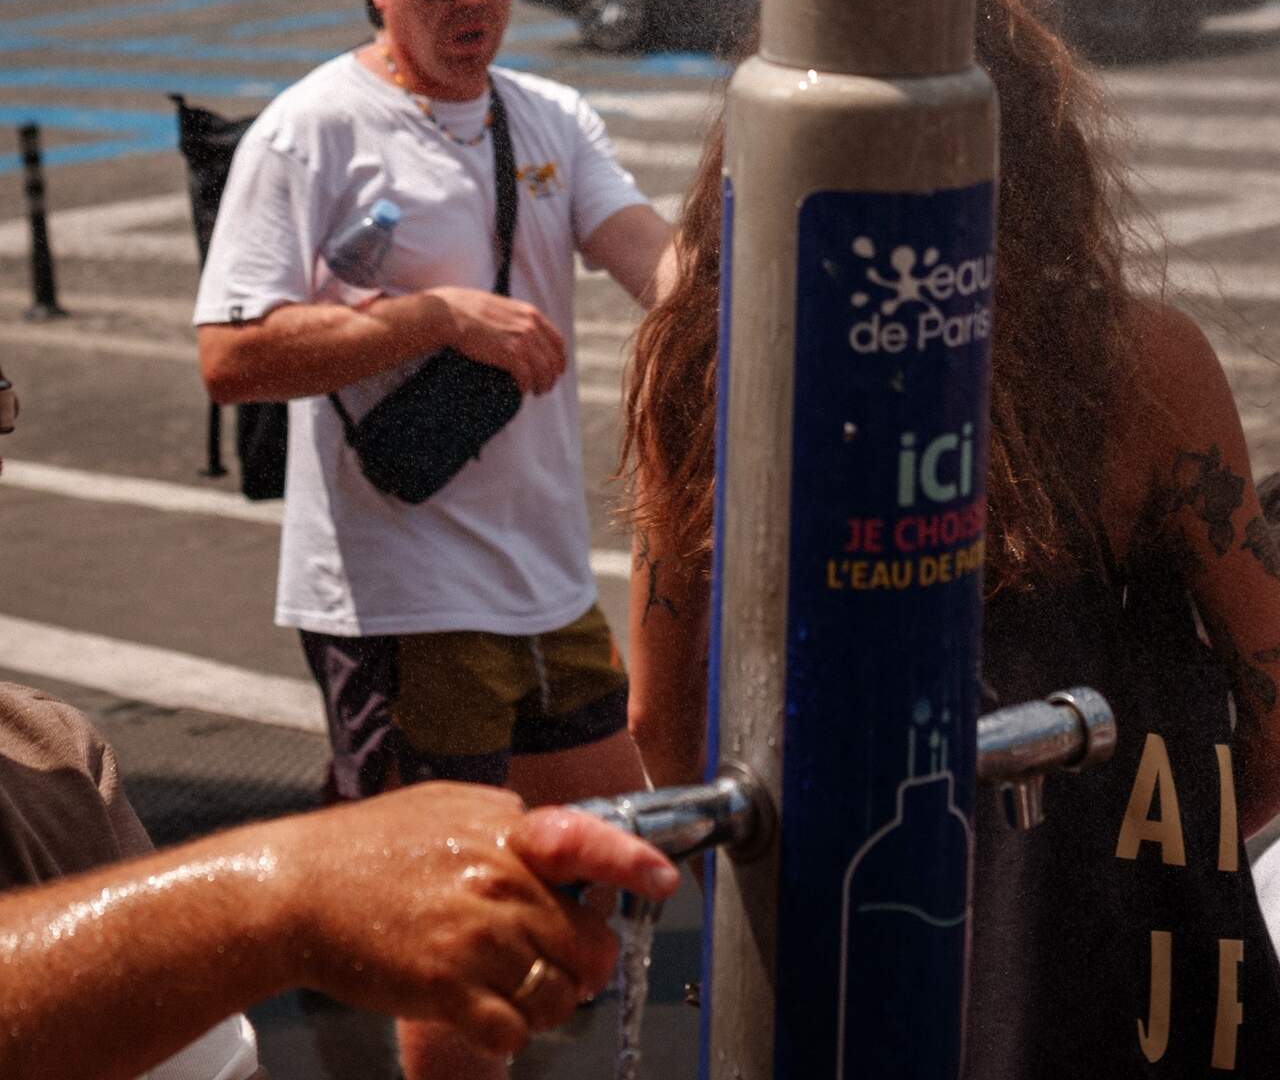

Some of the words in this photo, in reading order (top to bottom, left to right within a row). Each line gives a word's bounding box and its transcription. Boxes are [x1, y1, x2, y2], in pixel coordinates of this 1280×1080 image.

[929, 254, 993, 300] eau
[849, 314, 908, 353] de
[917, 303, 991, 351] Paris
[844, 518, 884, 553] JE
[827, 559, 914, 591] L'EAU
[920, 552, 954, 587] DE
